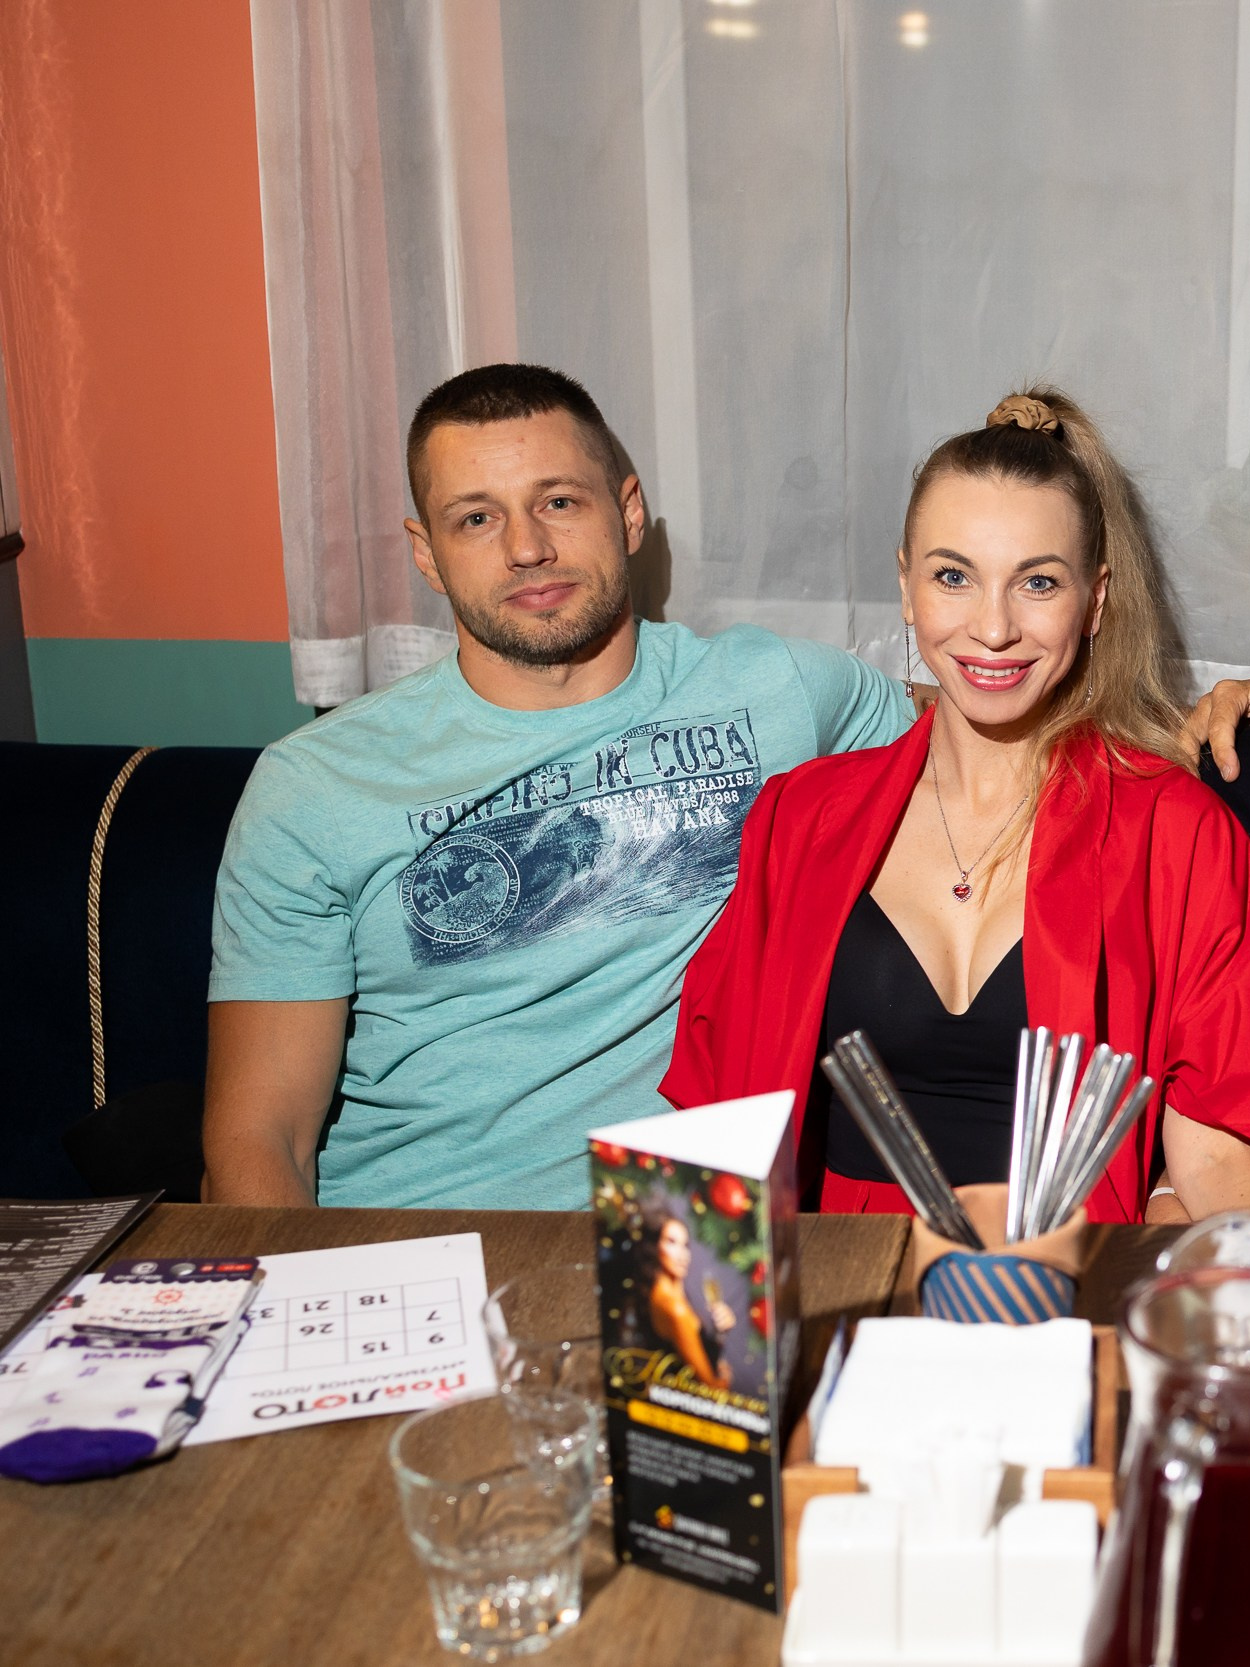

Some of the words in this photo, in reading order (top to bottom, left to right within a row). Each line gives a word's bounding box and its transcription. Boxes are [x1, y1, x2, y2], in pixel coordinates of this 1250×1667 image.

[617, 723, 661, 740] OURSELF
[650, 720, 754, 778] CUBA
[579, 786, 668, 816] TROPICAL
[676, 771, 755, 796] PARADISE
[606, 806, 646, 825] BLUE
[631, 806, 730, 840] HAVANA
[302, 1300, 331, 1313] 21
[359, 1293, 389, 1306] 18
[425, 1309, 442, 1322] 7
[299, 1323, 335, 1337] 26
[428, 1333, 445, 1345] 9
[361, 1341, 391, 1354] 15
